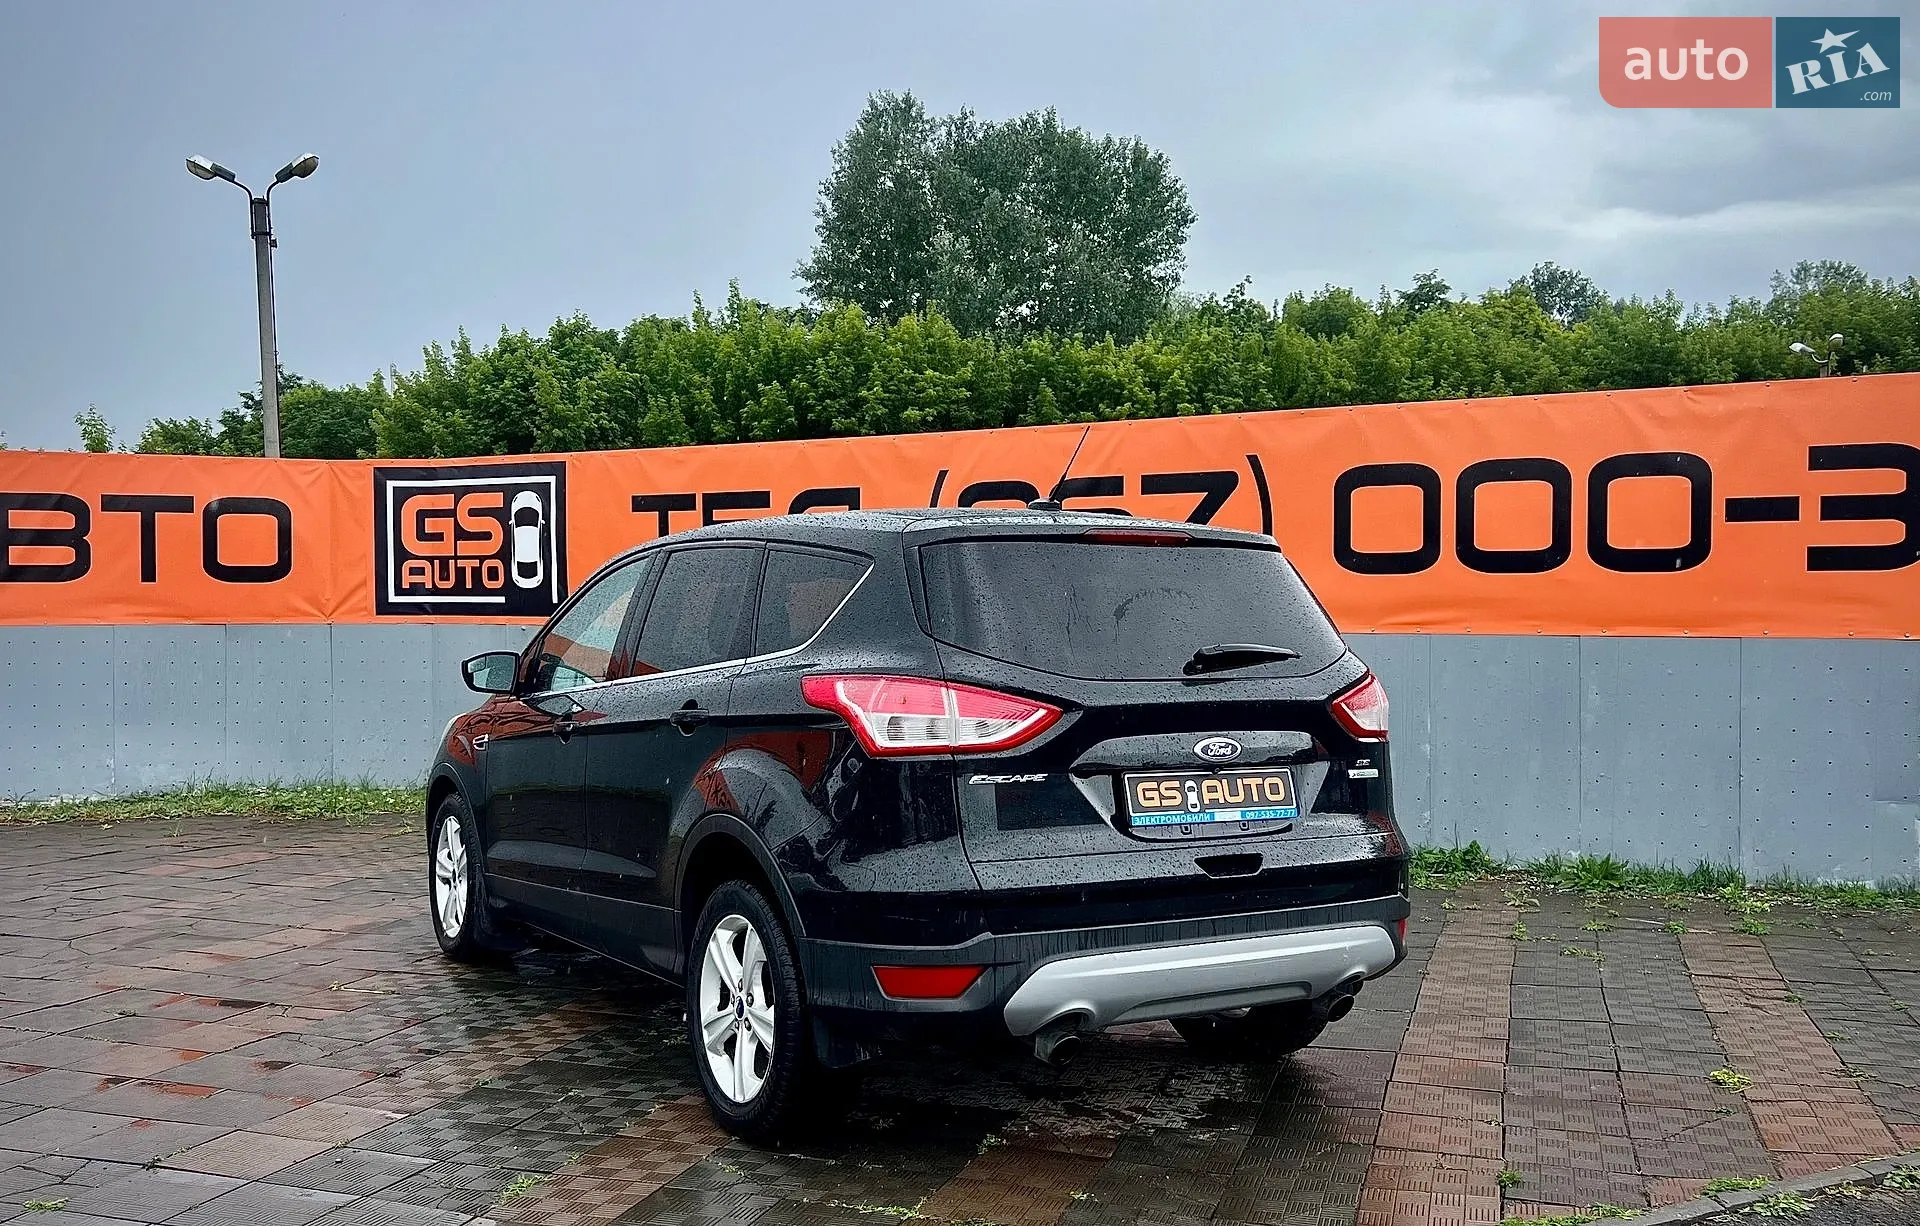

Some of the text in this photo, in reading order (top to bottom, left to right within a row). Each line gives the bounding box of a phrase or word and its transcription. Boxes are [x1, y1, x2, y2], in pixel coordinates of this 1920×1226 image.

[400, 491, 505, 557] GS
[401, 558, 505, 590] AUTO
[1207, 742, 1232, 757] Ford
[1136, 776, 1286, 808] GS AUTO
[1133, 813, 1211, 826] ЭЛЕКТРОМОБИЛИ
[1245, 809, 1296, 820] 097-535-77-77
